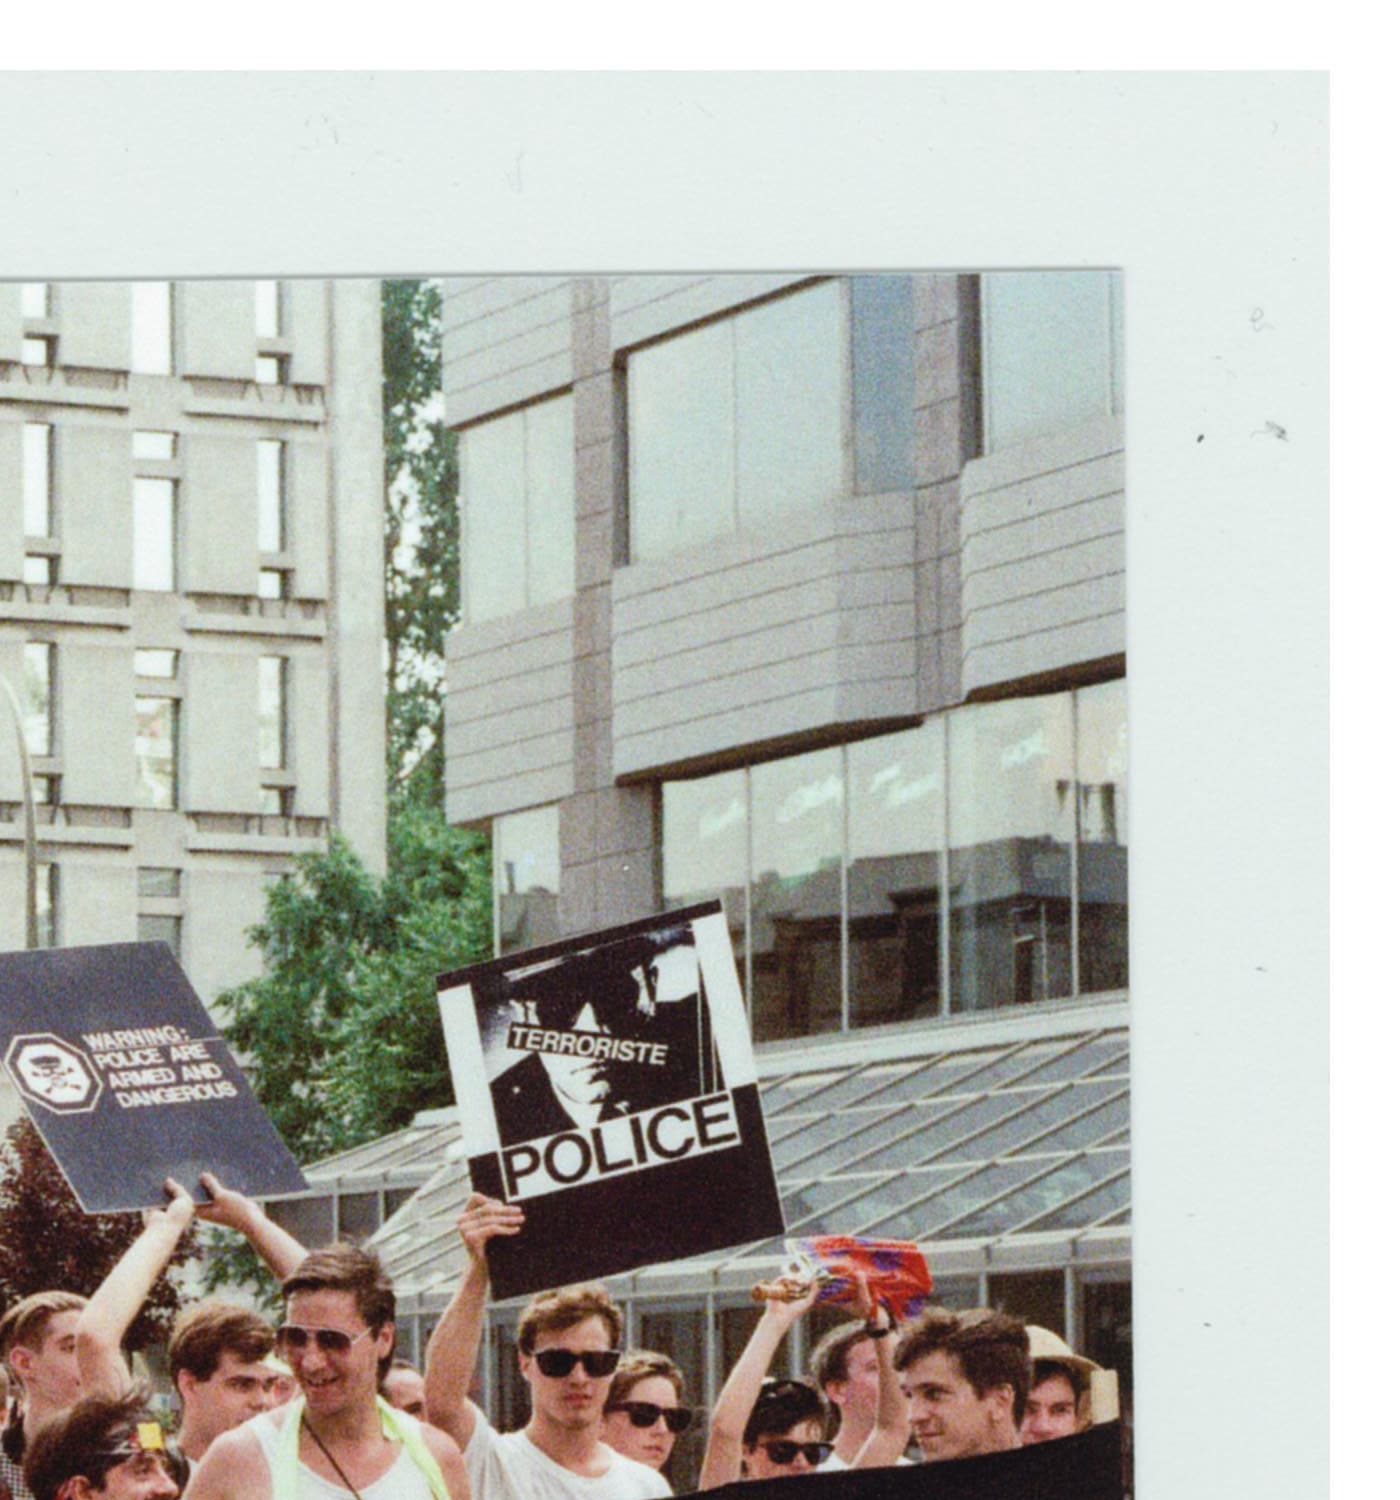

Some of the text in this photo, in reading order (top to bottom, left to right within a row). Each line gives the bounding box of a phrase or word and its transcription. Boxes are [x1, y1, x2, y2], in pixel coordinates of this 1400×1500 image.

[83, 1025, 190, 1051] WARNING:
[512, 1026, 668, 1066] TERRORISTE
[93, 1043, 210, 1070] POLICE ARE
[109, 1062, 222, 1088] ARMED AND
[116, 1081, 238, 1109] DANGEROUS
[503, 1095, 737, 1196] POLICE
